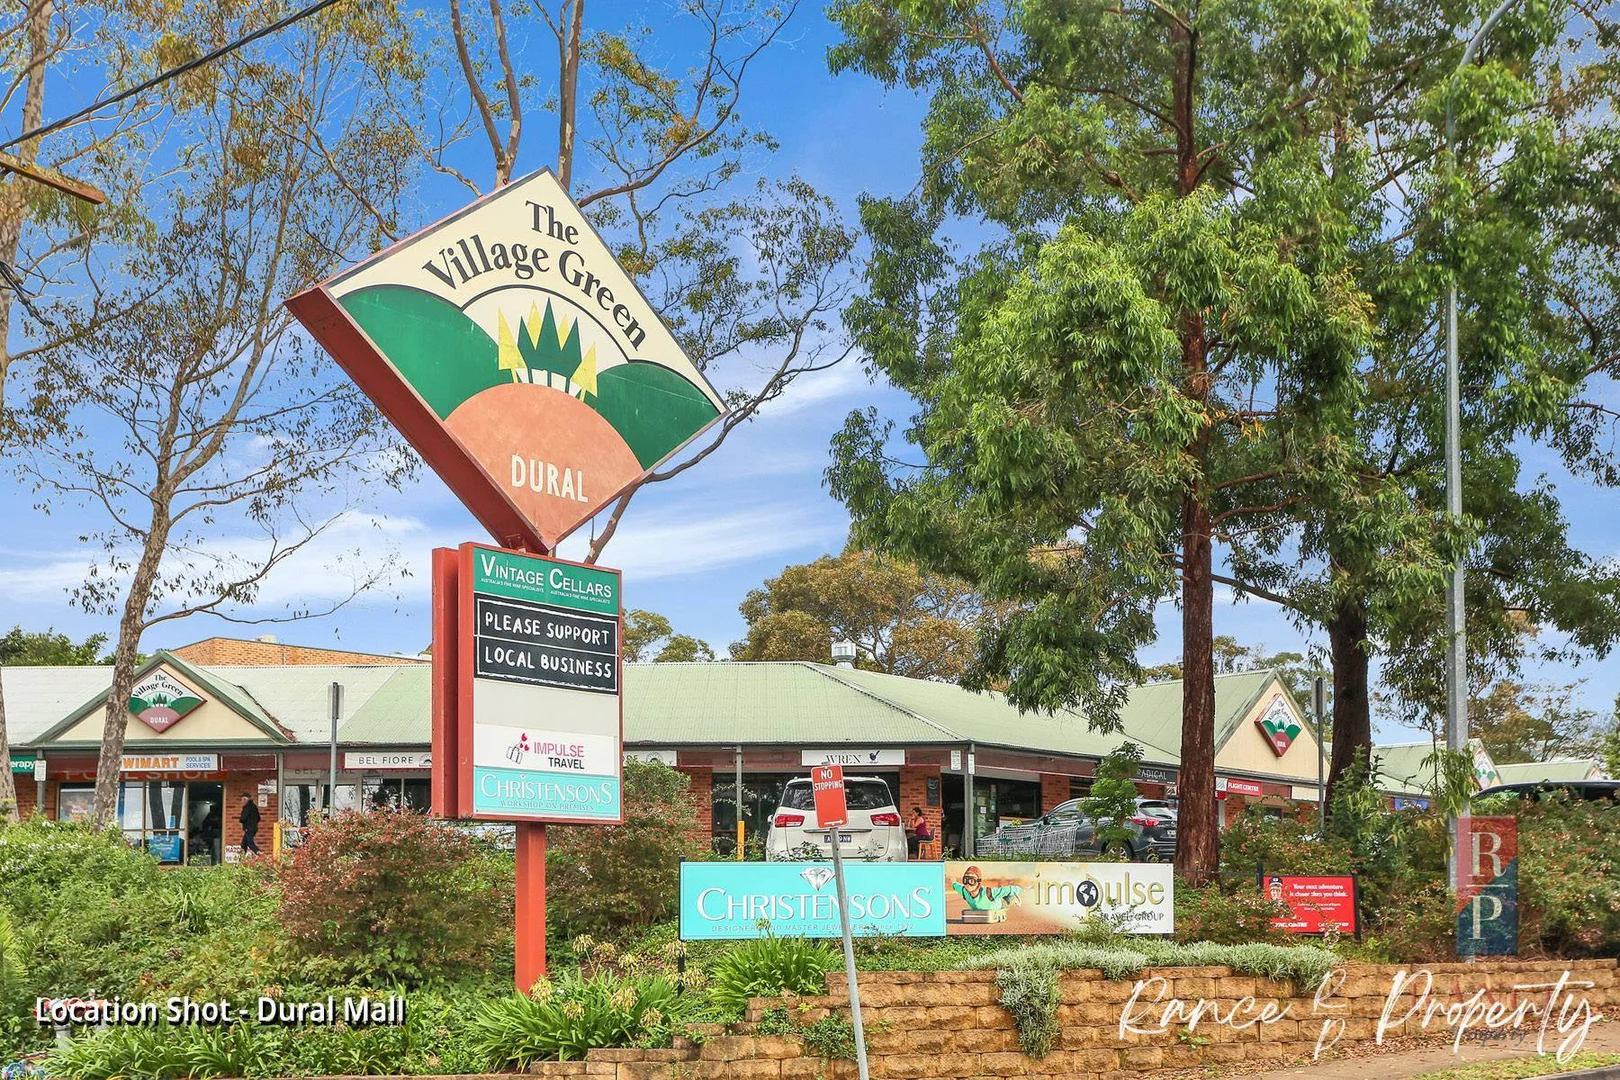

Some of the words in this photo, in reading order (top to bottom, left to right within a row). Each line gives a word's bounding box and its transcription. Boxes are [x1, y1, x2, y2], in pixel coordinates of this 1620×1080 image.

[525, 200, 579, 246] The
[422, 235, 550, 291] Village
[558, 249, 649, 353] Green
[511, 454, 589, 503] DURAL
[481, 553, 545, 587] VINTAGE
[549, 568, 612, 598] CELLARS
[485, 612, 541, 635] PLEASE
[546, 622, 610, 646] SUPPORT
[485, 646, 535, 669] LOCAL
[540, 654, 612, 679] BUSINESS
[132, 682, 160, 698] Village
[161, 681, 184, 697] Green
[533, 742, 585, 758] IMPULSE
[358, 757, 378, 765] BEL
[382, 756, 414, 765] FIORE
[548, 757, 585, 770] TRAVEL
[826, 755, 862, 764] WREN
[820, 769, 833, 780] NO
[481, 773, 613, 805] CHRISTENSONS
[814, 780, 843, 792] STOPPING
[1228, 782, 1243, 790] FLIGHT
[500, 800, 544, 809] WORKSHOP
[560, 803, 595, 811] PREMISES
[697, 886, 931, 921] CHRISTENSONS
[1035, 871, 1165, 922] impulse
[1133, 911, 1165, 921] GROUP
[786, 923, 818, 931] MASTER
